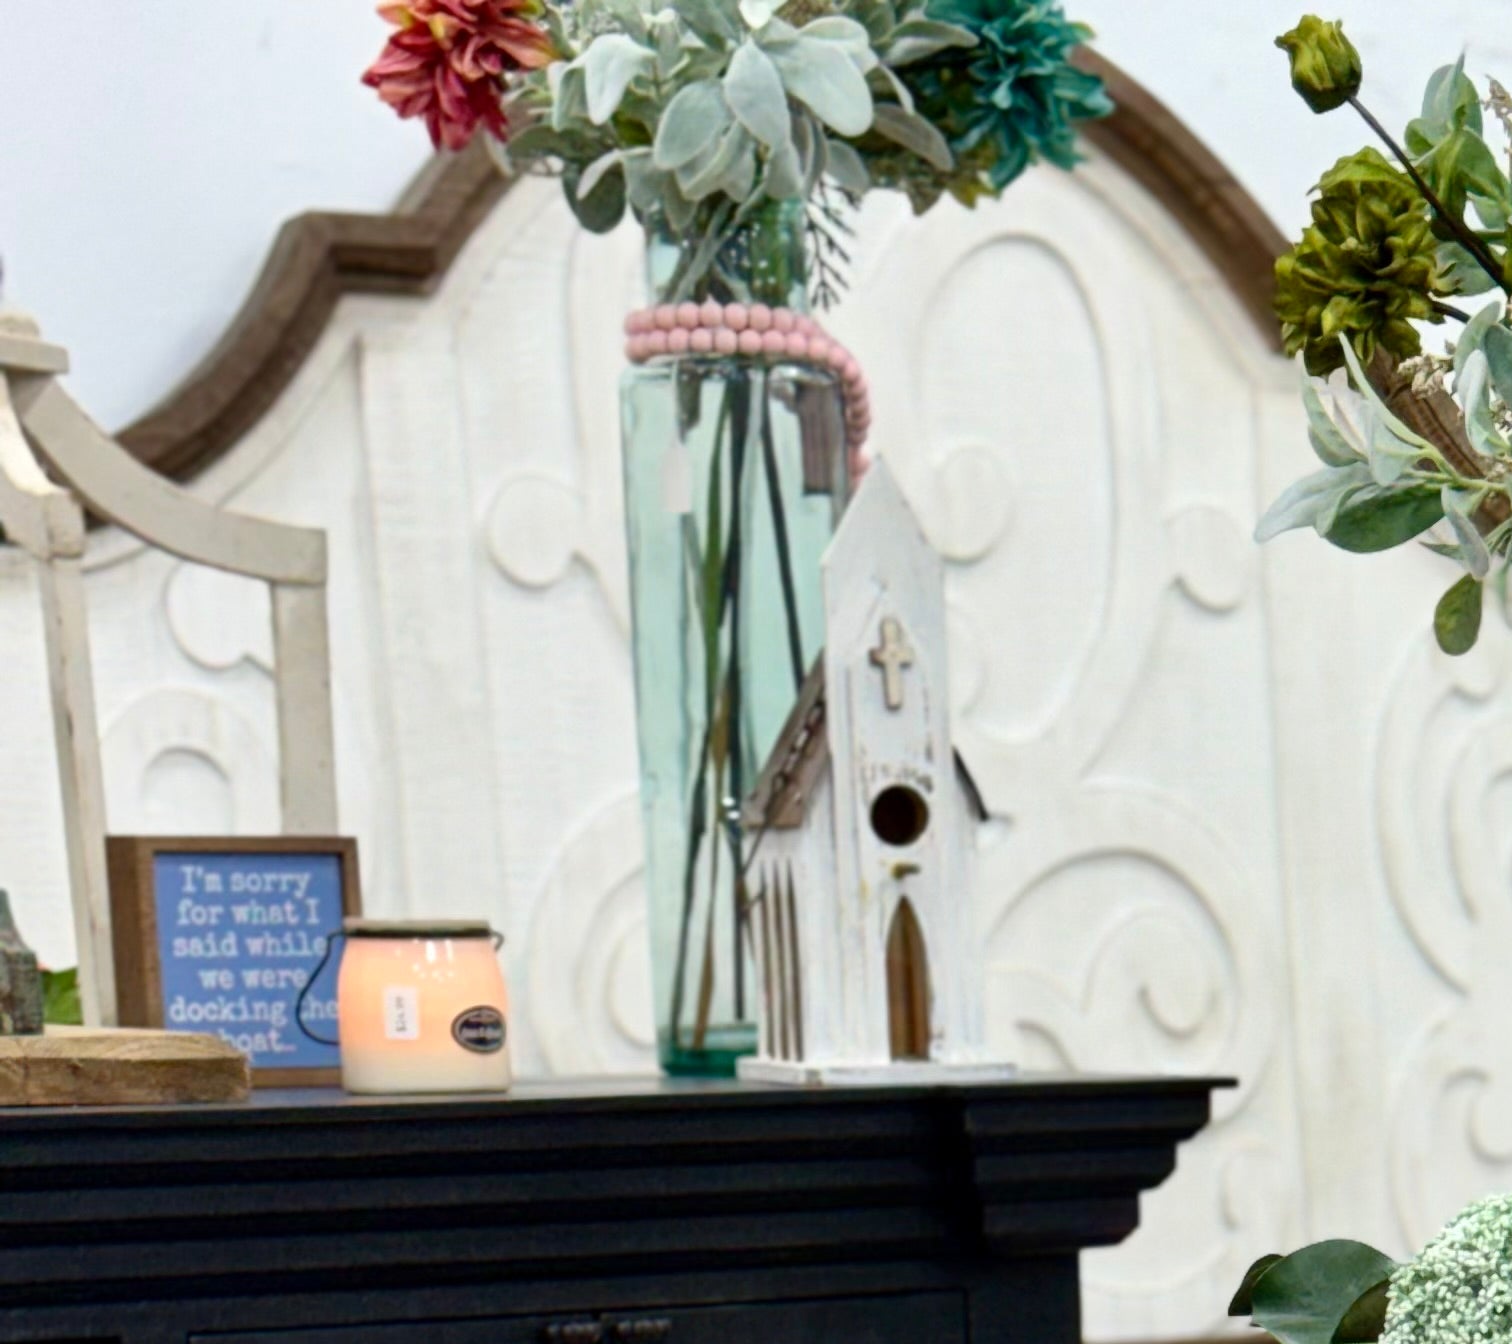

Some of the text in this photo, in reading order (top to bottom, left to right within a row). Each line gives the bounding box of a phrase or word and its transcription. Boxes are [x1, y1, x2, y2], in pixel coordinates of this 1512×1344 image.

[180, 864, 311, 899] I'm sorry
[177, 898, 320, 926] for what I
[172, 930, 328, 958] said while
[198, 968, 307, 989] we were
[169, 996, 287, 1027] docking
